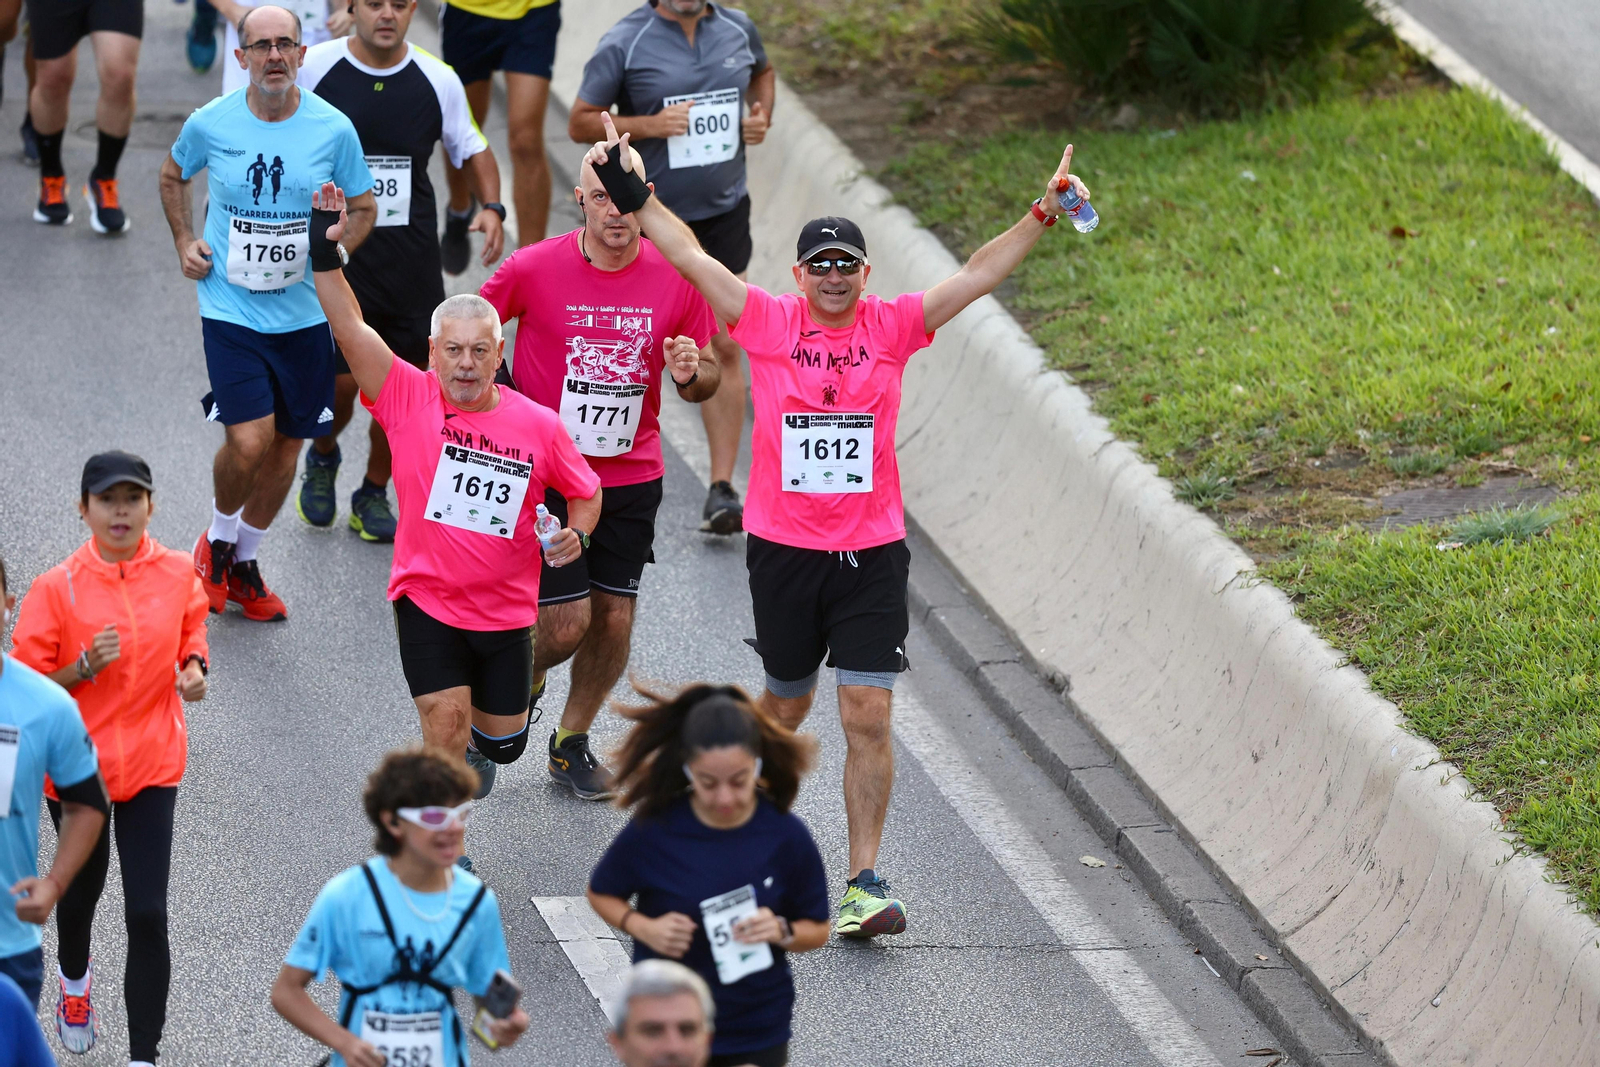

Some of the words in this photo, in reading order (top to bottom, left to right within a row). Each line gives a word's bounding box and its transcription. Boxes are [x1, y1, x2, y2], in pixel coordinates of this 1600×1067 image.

[239, 209, 278, 219] CARRERA
[233, 219, 252, 235] 43
[282, 220, 307, 229] URBANA
[276, 227, 307, 237] MALAGA
[243, 243, 296, 263] 1766
[566, 378, 590, 396] 43
[590, 383, 622, 391] CARRERA
[615, 389, 645, 398] MALAGA
[577, 403, 630, 427] 1771
[785, 415, 810, 429] 43
[799, 438, 859, 460] 1612
[470, 451, 503, 465] CARRERA
[468, 457, 490, 467] CIUDAD
[494, 465, 530, 480] MALAGA
[452, 472, 511, 504] 1613
